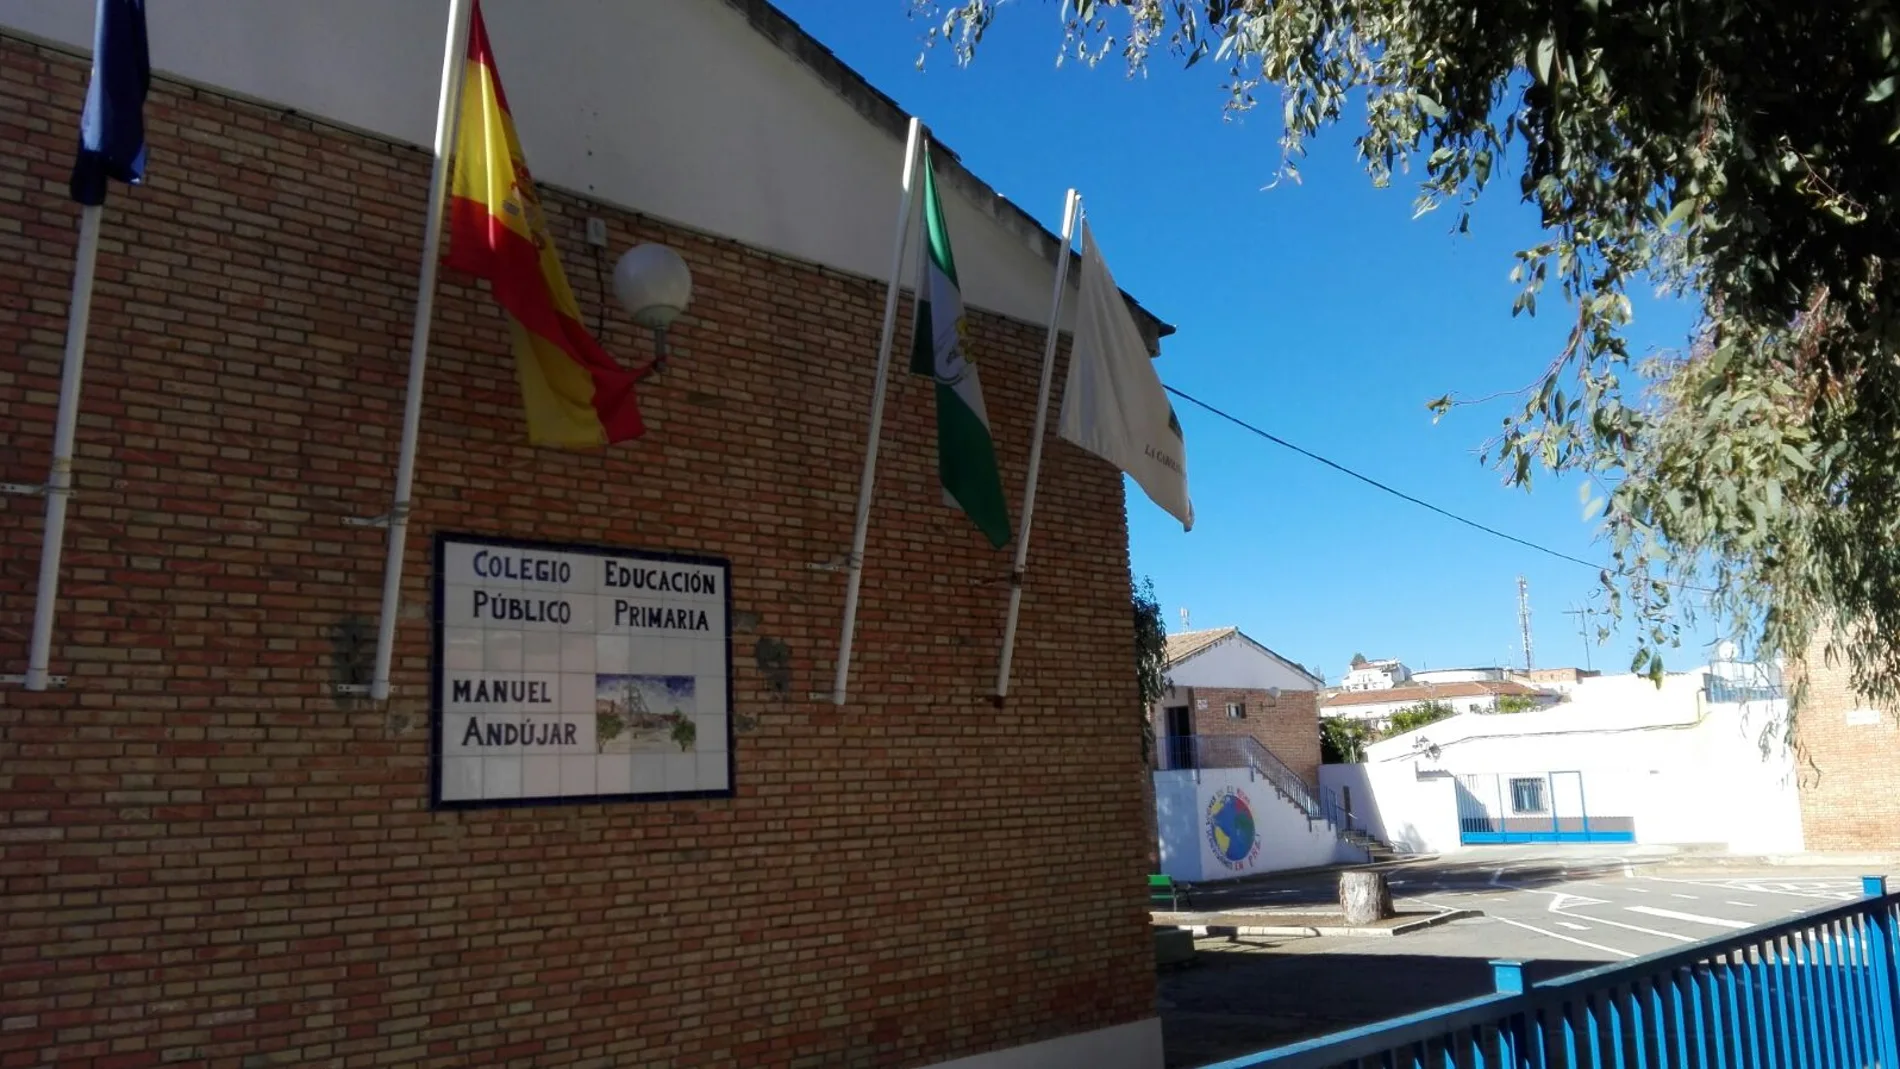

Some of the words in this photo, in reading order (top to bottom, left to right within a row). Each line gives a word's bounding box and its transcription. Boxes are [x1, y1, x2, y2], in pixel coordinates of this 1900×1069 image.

[473, 550, 571, 583] COLEGIO
[604, 560, 716, 595] EDUCACIÓN
[473, 590, 571, 625] PÚBLICO
[614, 599, 709, 631] PRIMARIA
[452, 679, 552, 703] MANUEL
[461, 716, 577, 747] ANDÚJAR
